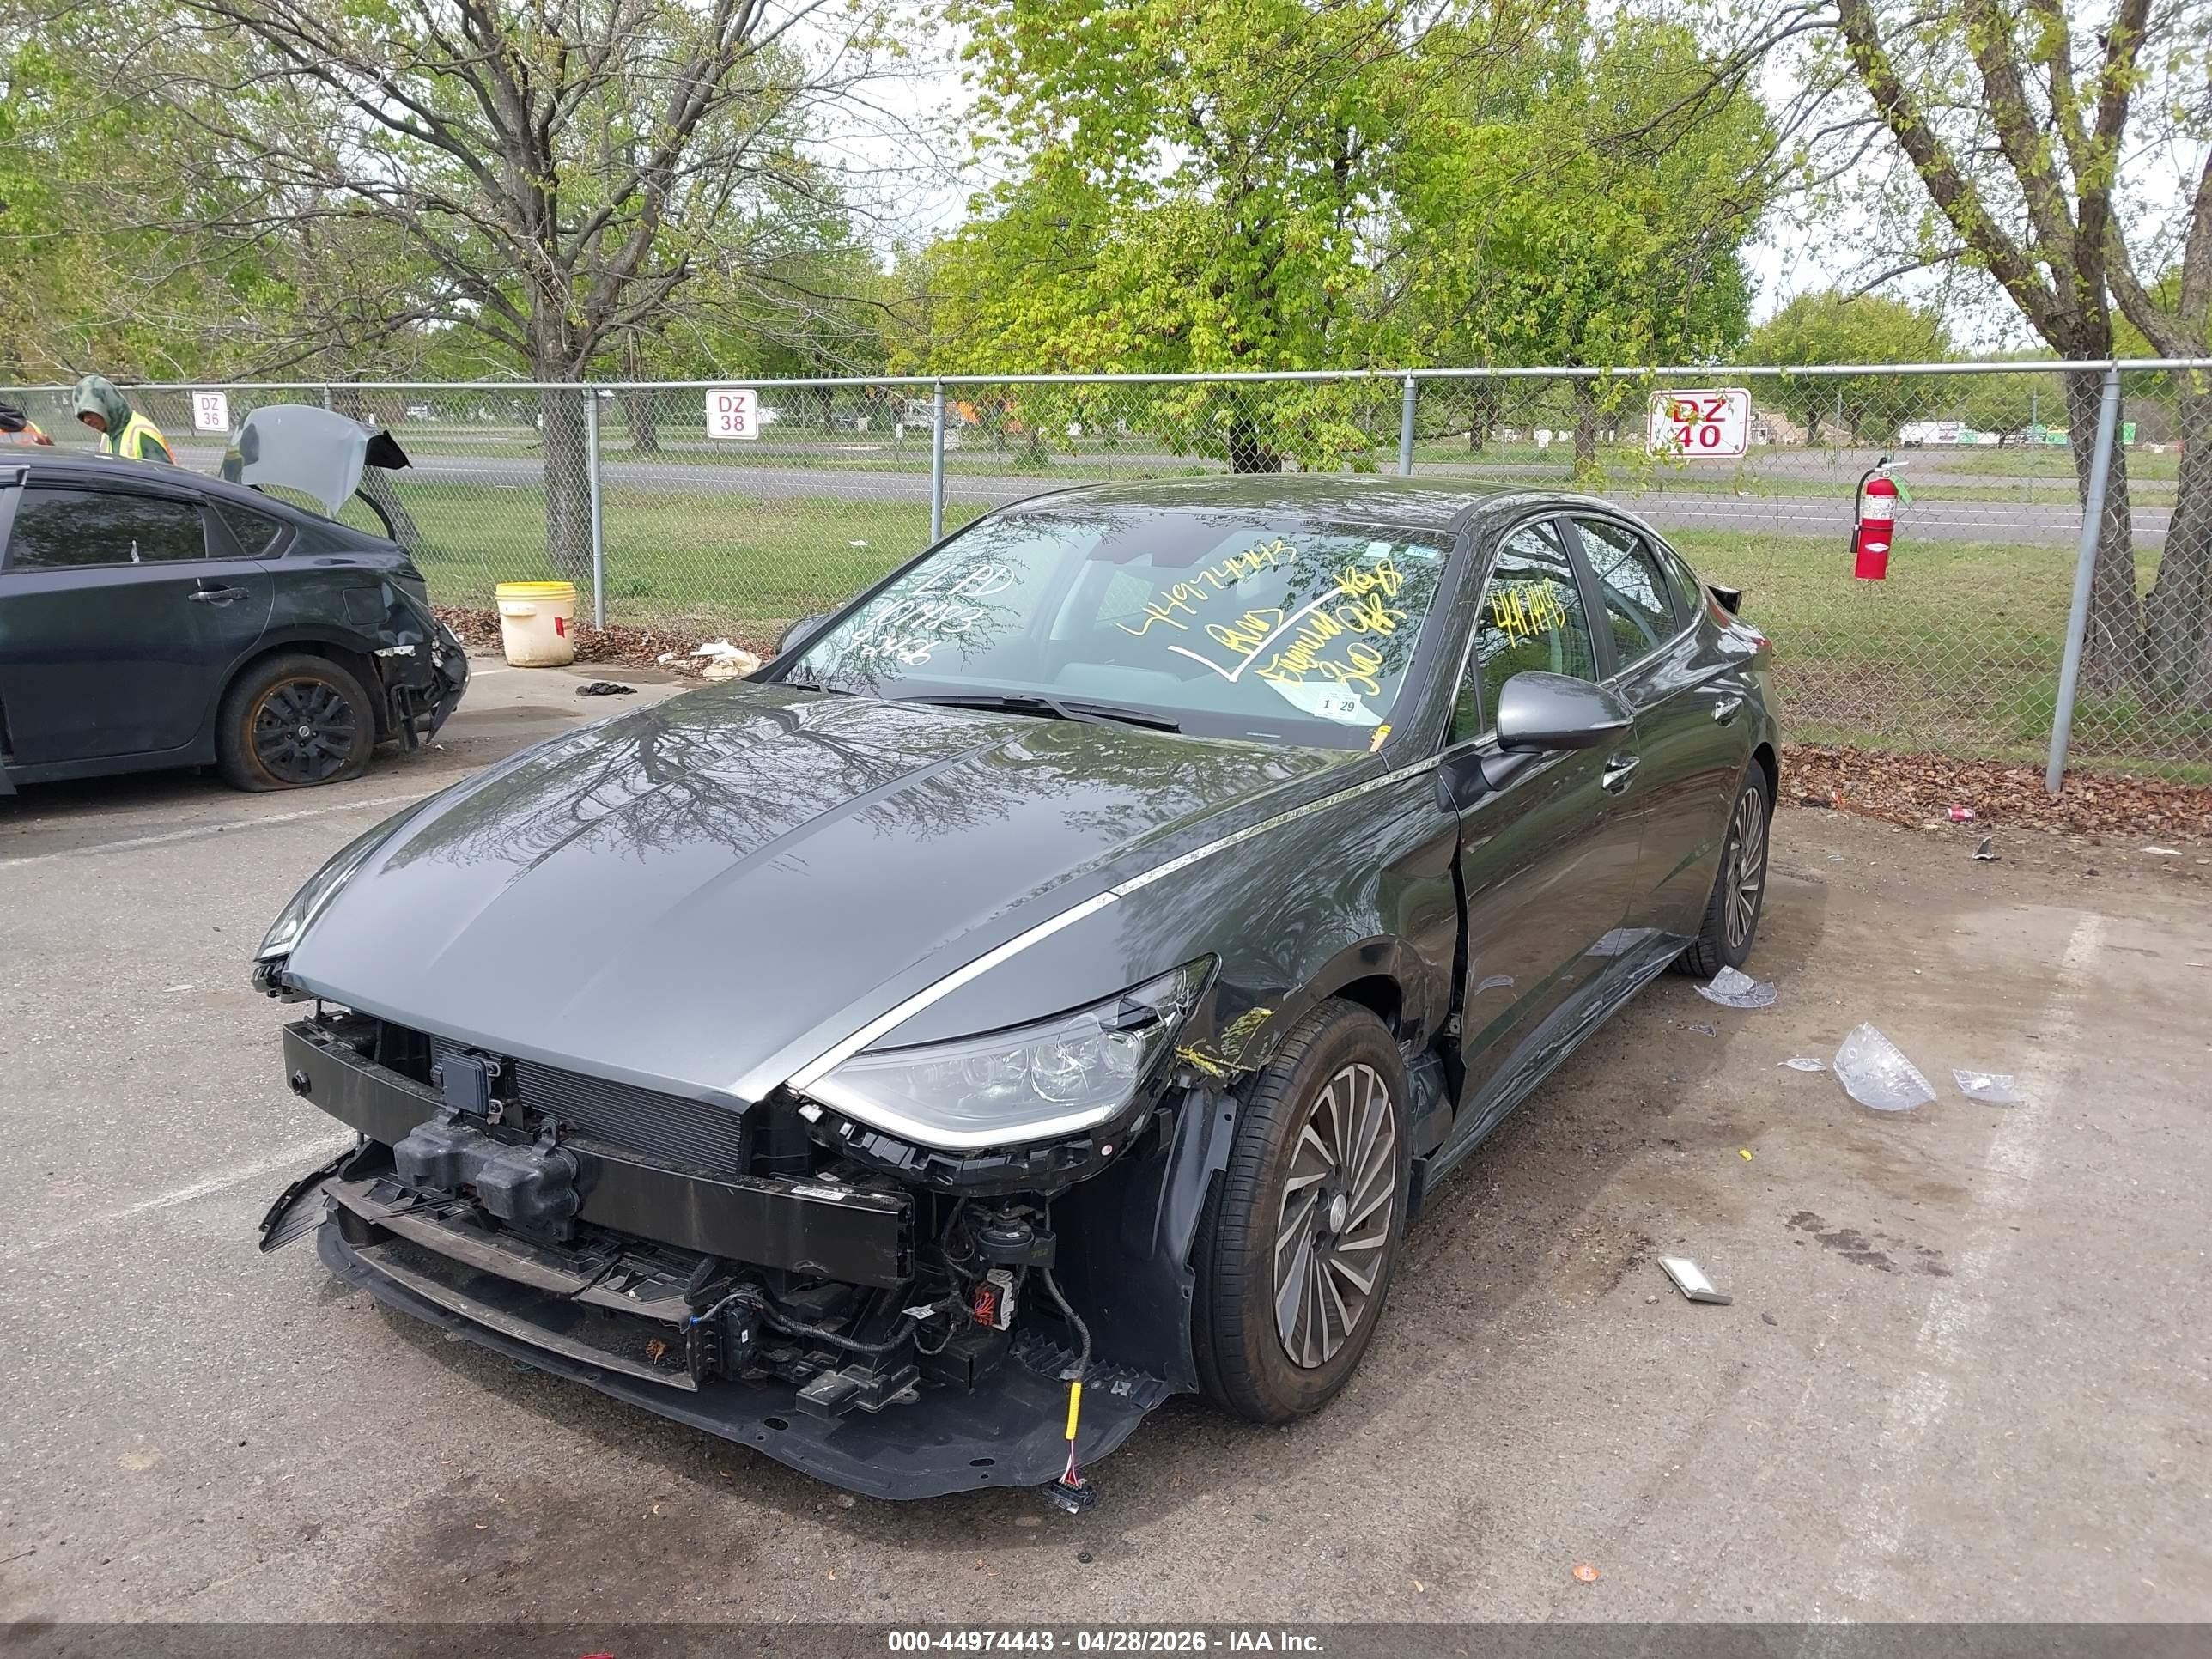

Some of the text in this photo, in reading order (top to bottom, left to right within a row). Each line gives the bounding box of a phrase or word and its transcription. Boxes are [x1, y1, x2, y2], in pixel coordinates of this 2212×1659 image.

[201, 398, 220, 410] DZ
[718, 396, 746, 413] DZ
[1672, 398, 1727, 422] DZ
[203, 412, 220, 426] 36
[720, 415, 744, 431] 38
[1675, 424, 1721, 448] 40
[911, 563, 1016, 597] LPD
[1324, 699, 1355, 712] 1 29
